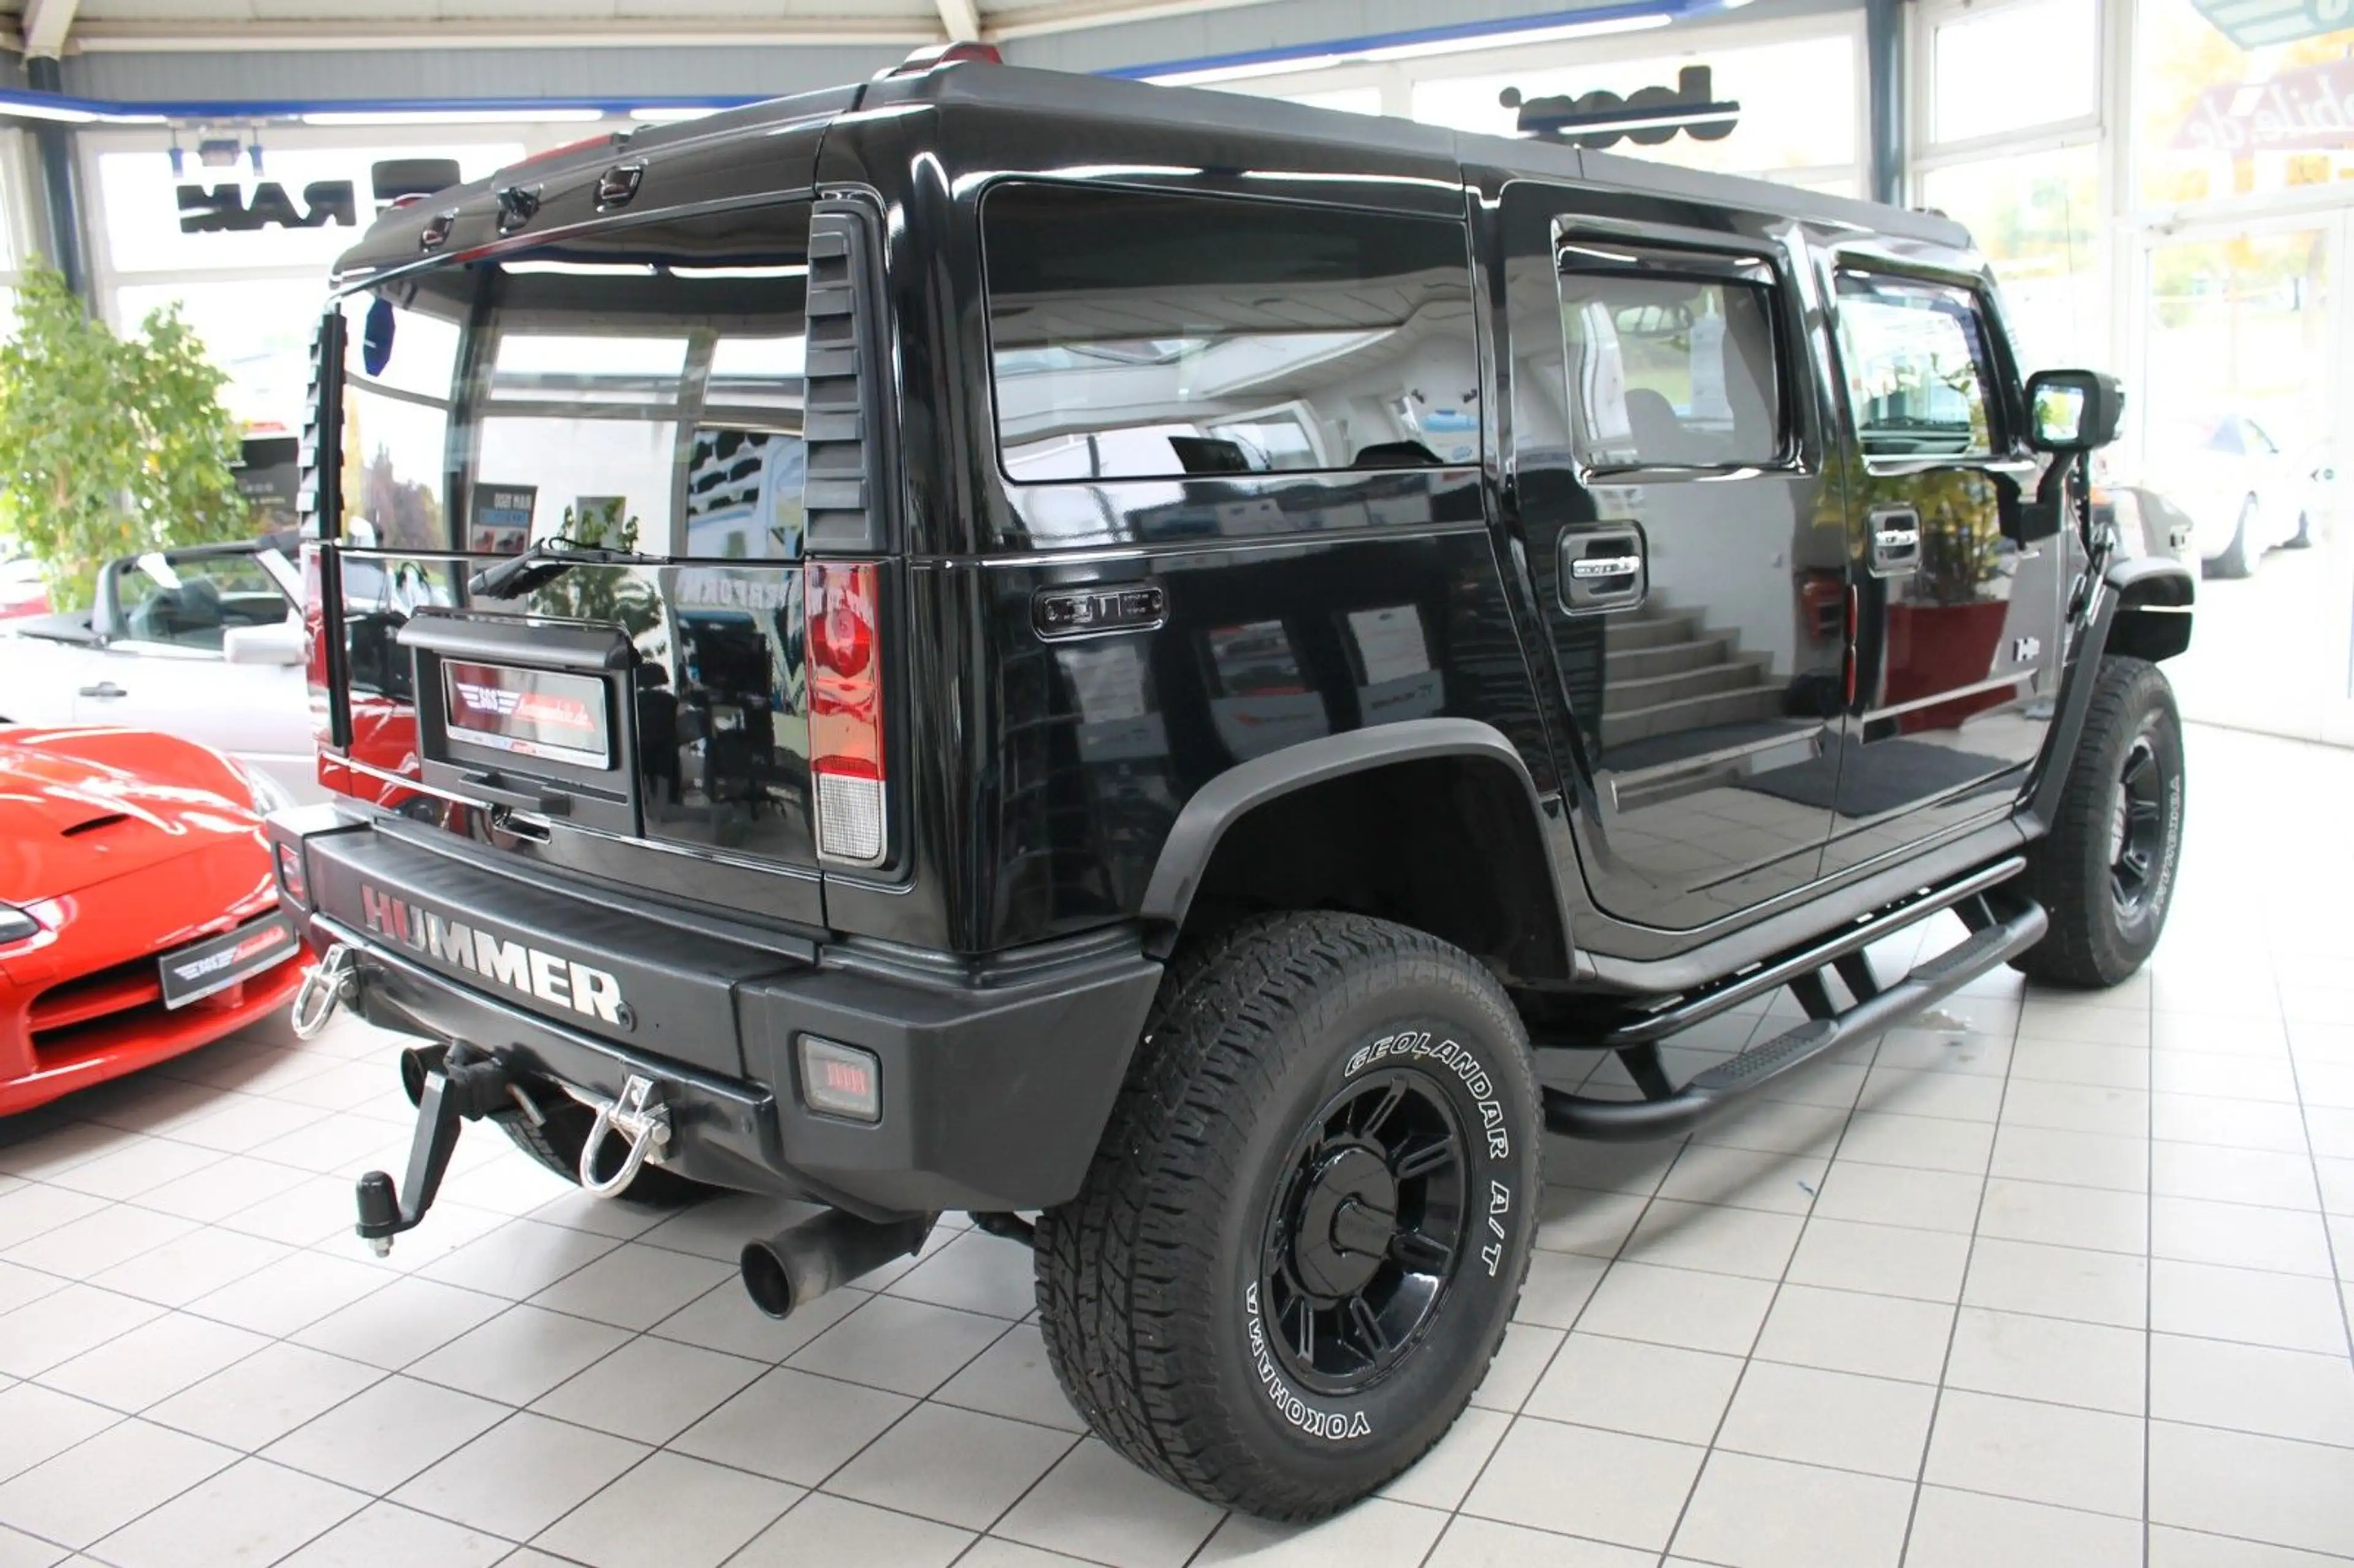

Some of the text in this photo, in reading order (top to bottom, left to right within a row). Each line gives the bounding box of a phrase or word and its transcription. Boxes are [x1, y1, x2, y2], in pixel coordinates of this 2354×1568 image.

[361, 884, 622, 1025] HUMMER
[1344, 1032, 1510, 1276] GEOLANDAR A/T
[1246, 1281, 1372, 1440] YOKOHAMA
